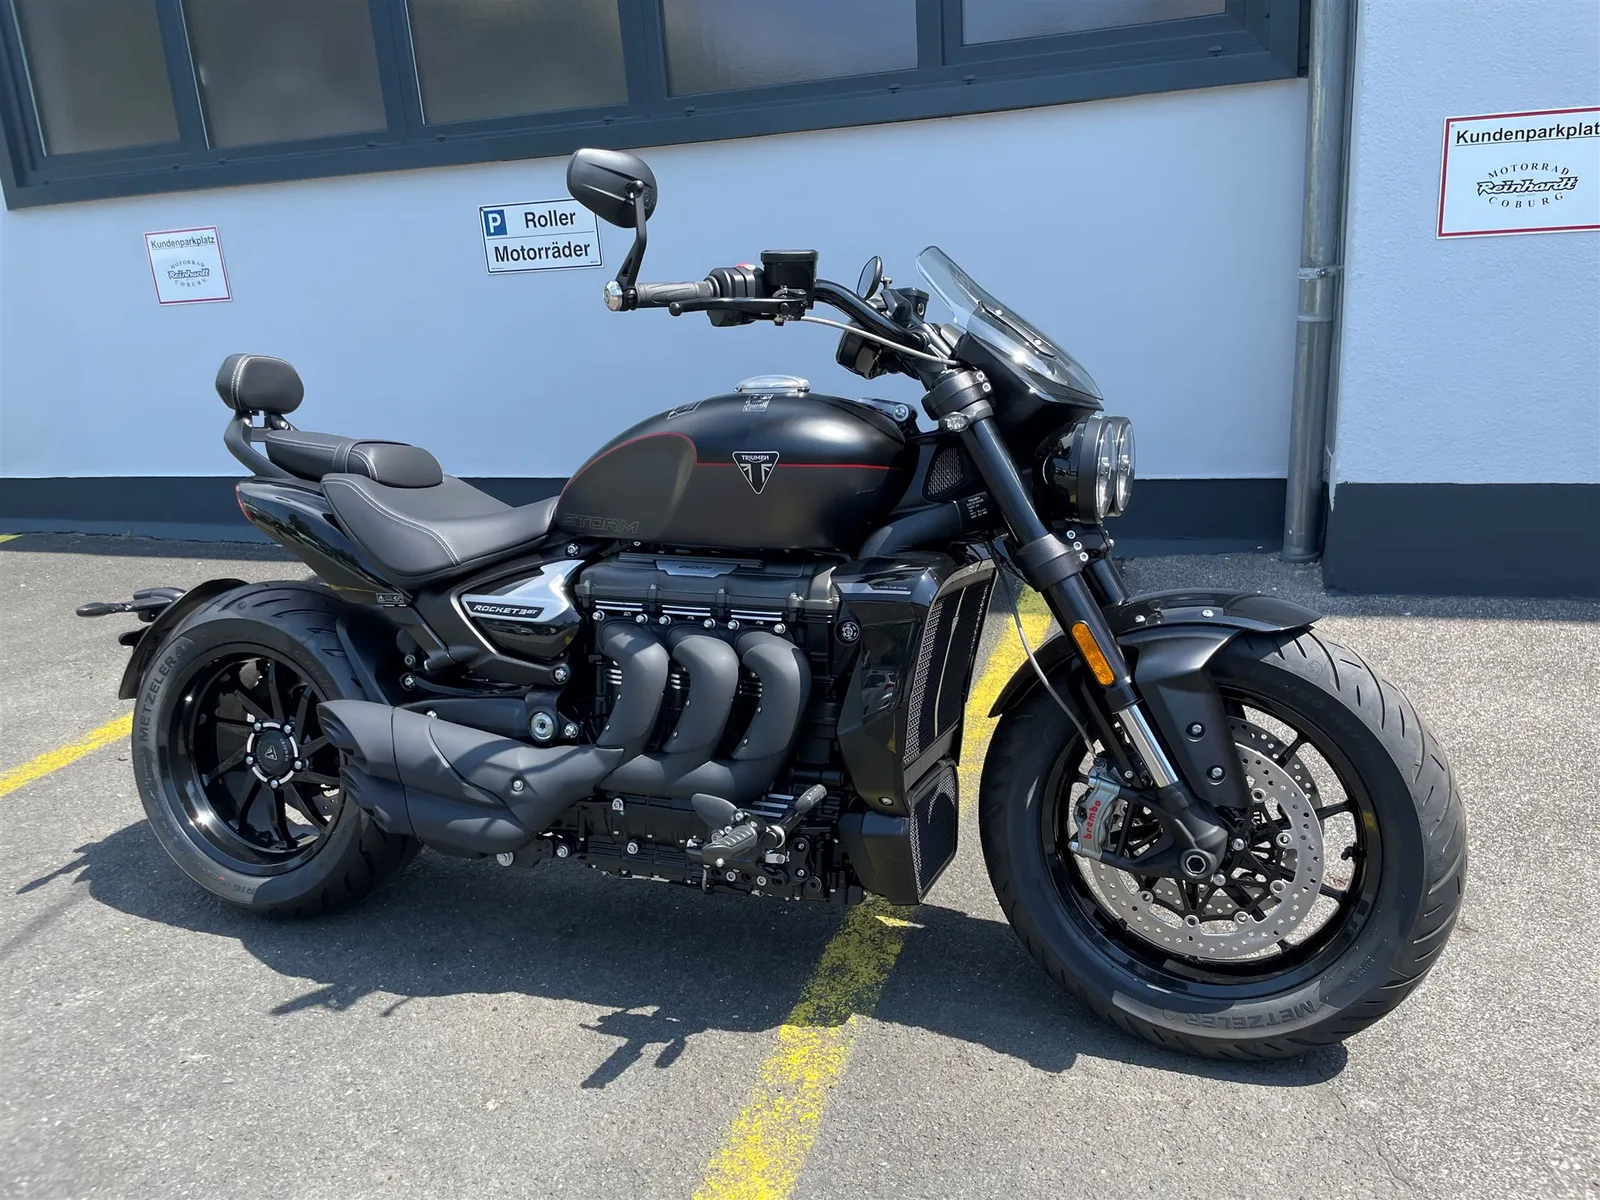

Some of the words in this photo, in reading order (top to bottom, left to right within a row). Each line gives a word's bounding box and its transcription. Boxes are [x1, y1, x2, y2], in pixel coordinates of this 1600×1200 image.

[1488, 162, 1570, 180] MOTORRAD
[1477, 176, 1579, 196] Reinhardt
[1488, 192, 1564, 208] COBURG
[487, 213, 501, 234] P
[524, 209, 576, 229] Roller
[151, 235, 216, 249] Kundenparkplatz
[494, 241, 591, 263] Motorräder
[170, 259, 205, 269] MOTORRAD
[562, 513, 639, 533] STORM
[138, 655, 178, 742] METZELER
[1083, 800, 1102, 839] brembo
[1184, 999, 1317, 1030] METZELER
